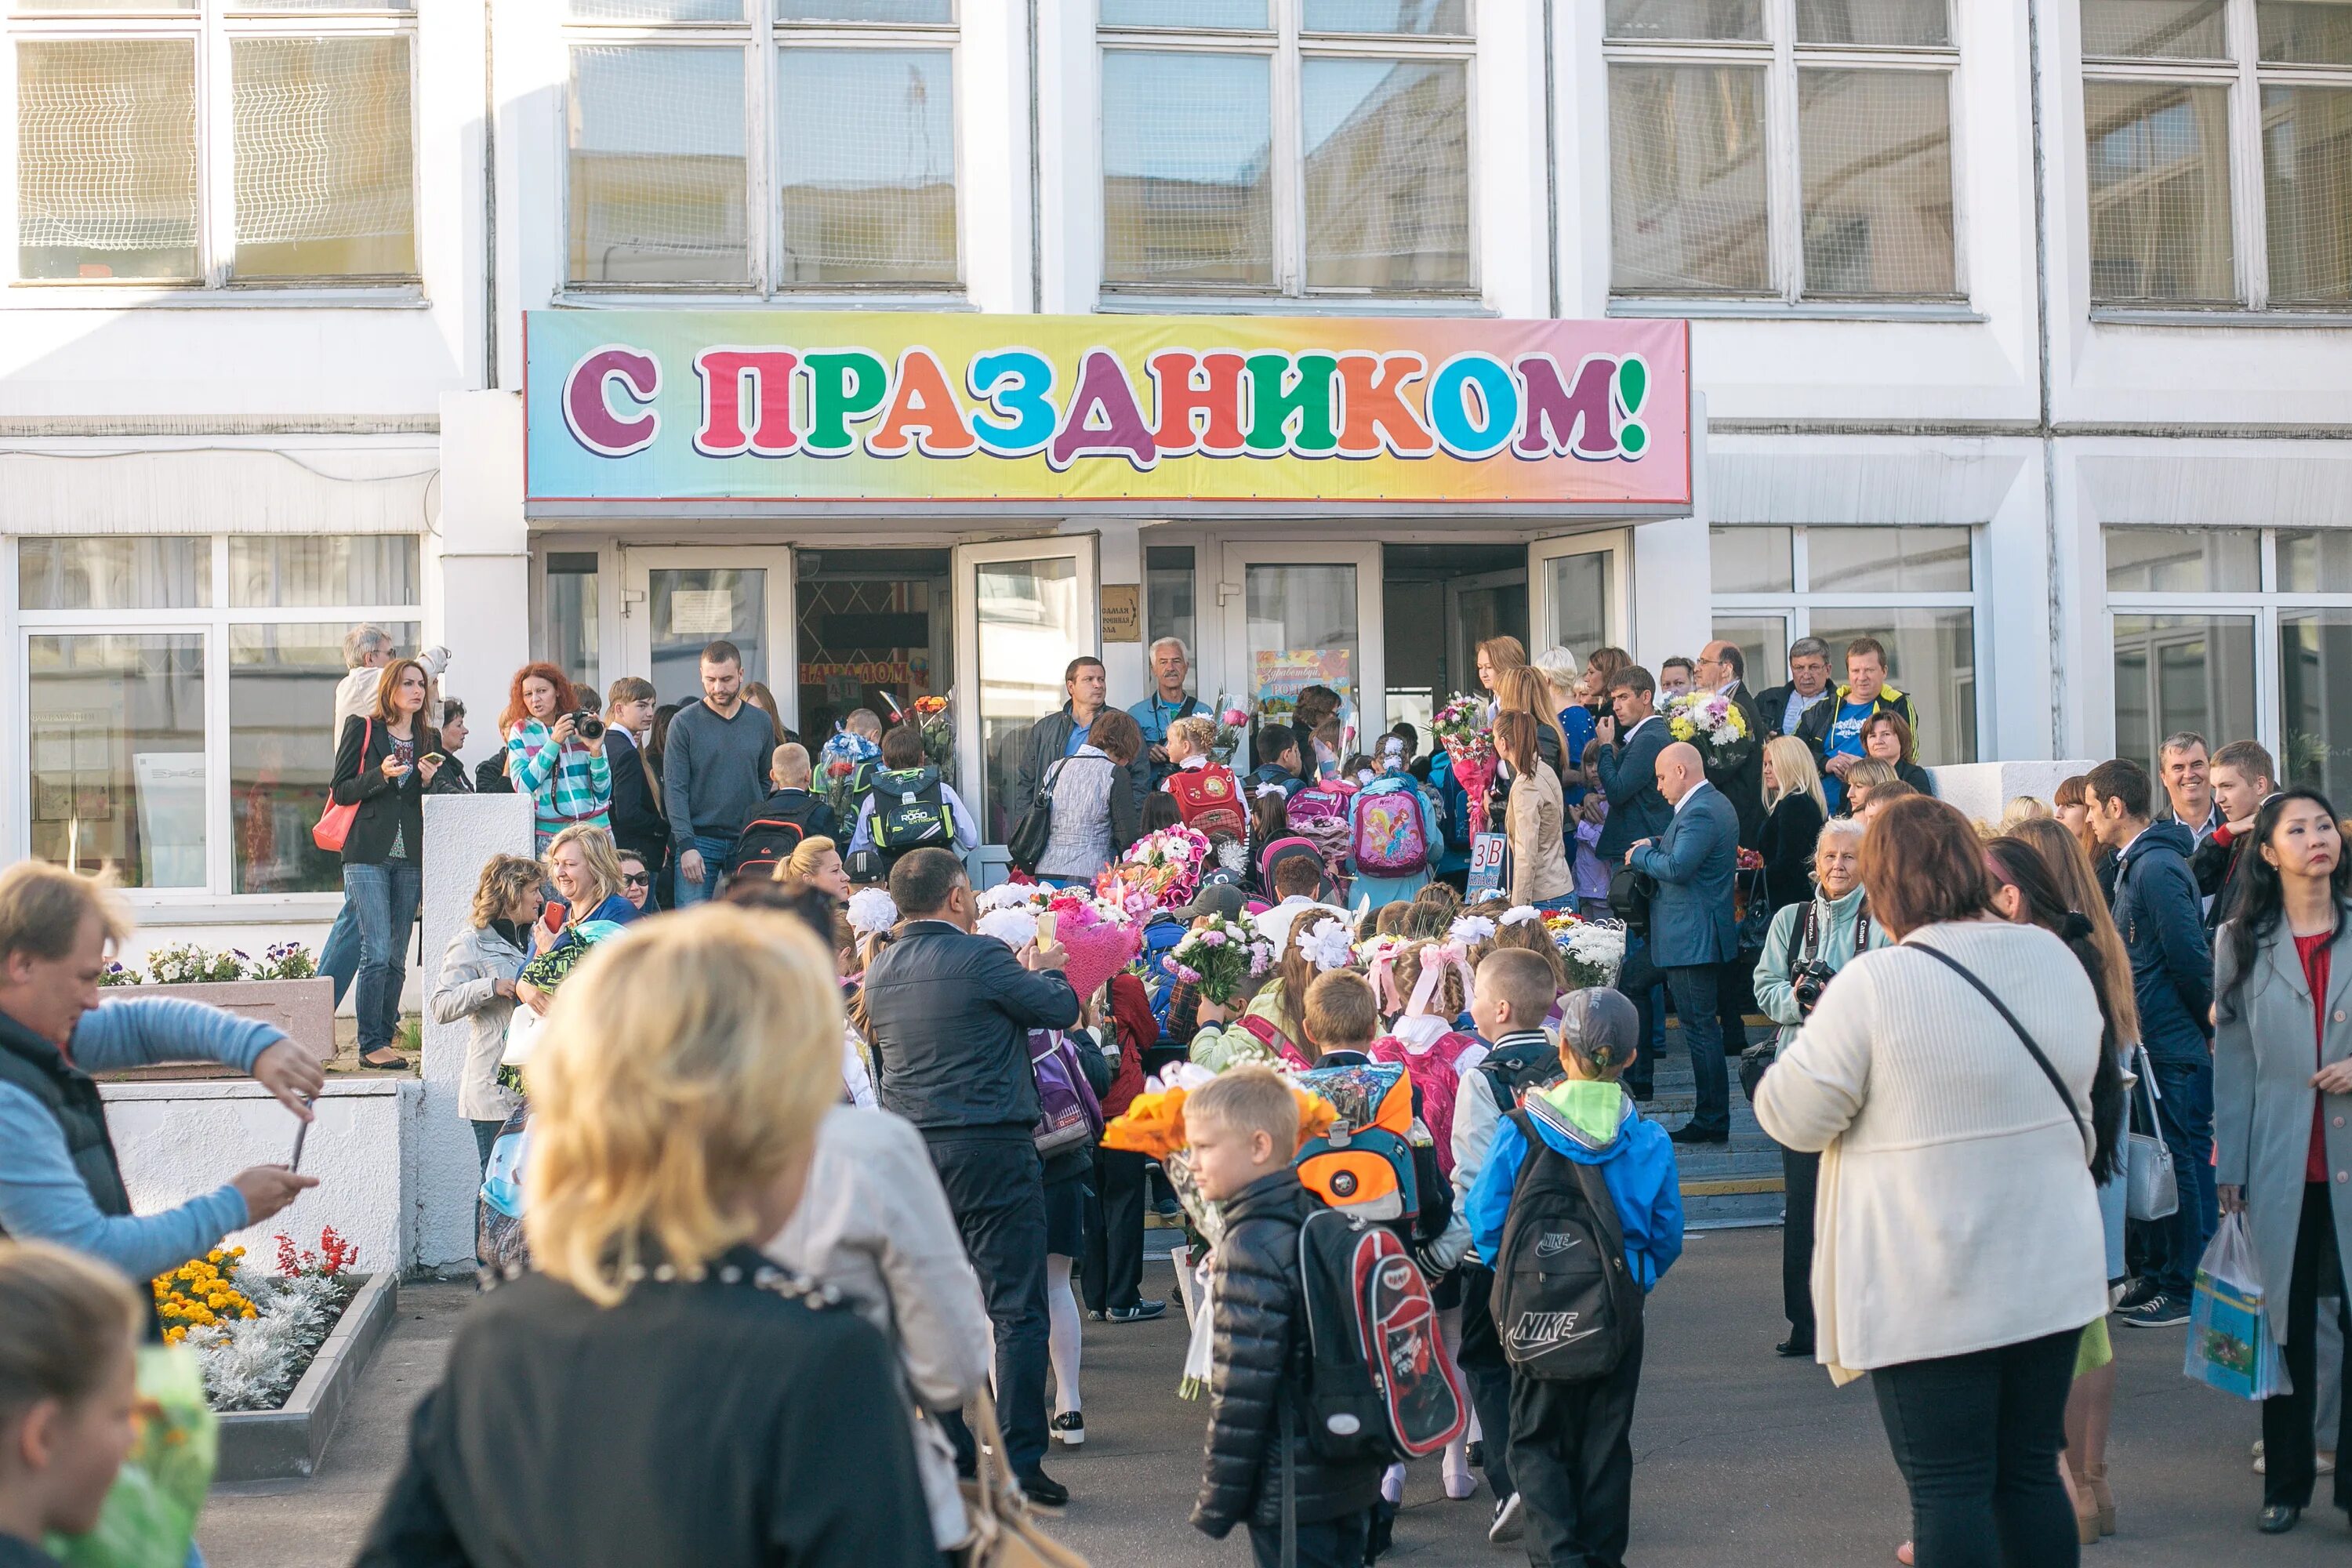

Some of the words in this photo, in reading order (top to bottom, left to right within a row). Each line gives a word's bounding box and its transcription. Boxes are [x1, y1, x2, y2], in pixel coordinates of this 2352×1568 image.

[563, 343, 663, 459] С
[691, 344, 1652, 471] ПРАЗДНИКОМ!
[901, 811, 928, 822] ROAD
[1475, 840, 1502, 867] 3В
[1468, 873, 1499, 886] КЛАСС
[1543, 1232, 1570, 1248] NIKE
[1513, 1312, 1578, 1341] NIKE
